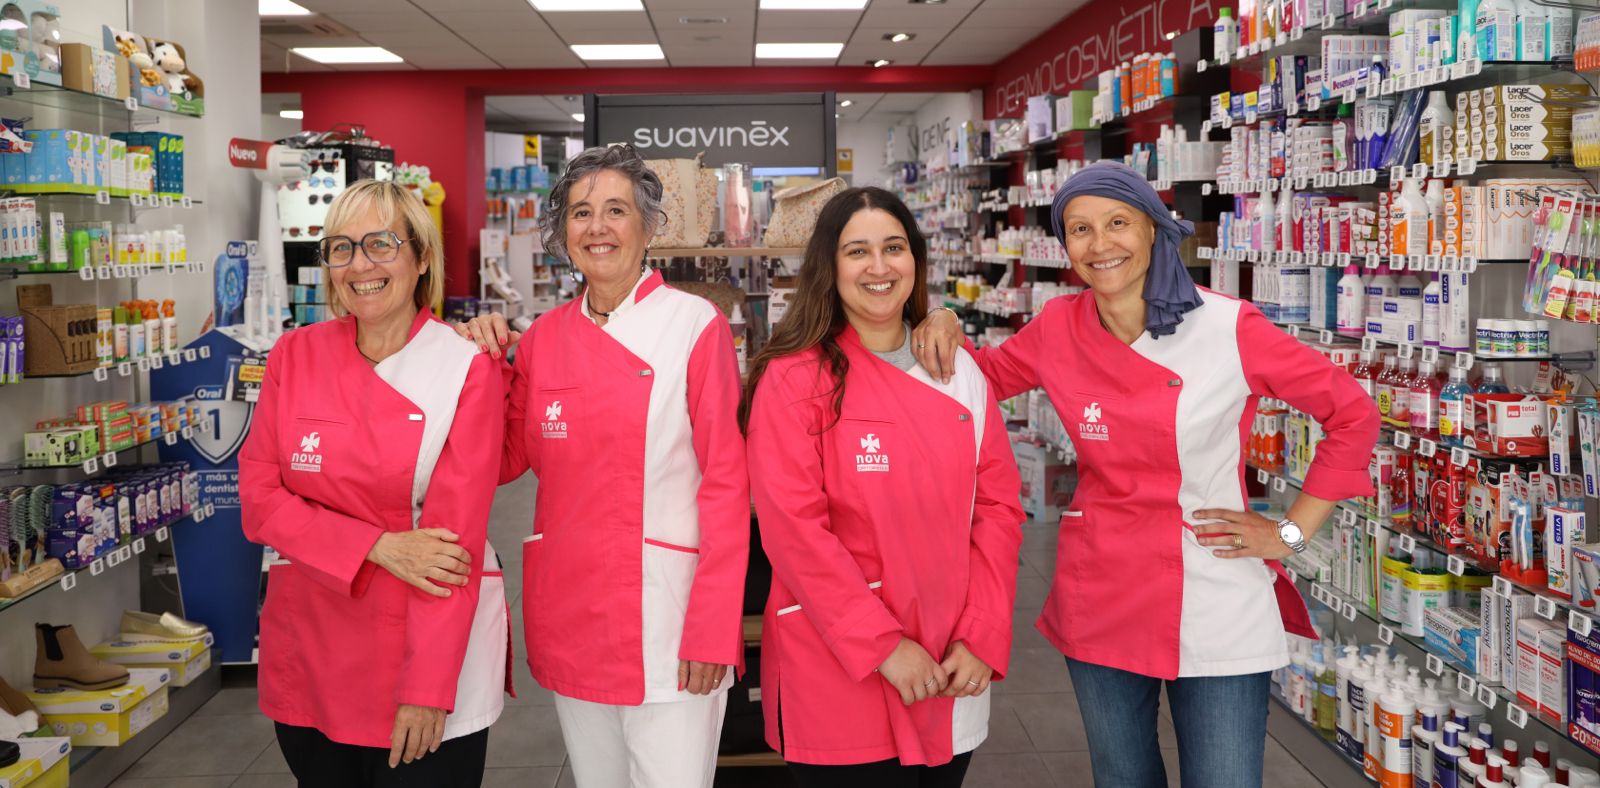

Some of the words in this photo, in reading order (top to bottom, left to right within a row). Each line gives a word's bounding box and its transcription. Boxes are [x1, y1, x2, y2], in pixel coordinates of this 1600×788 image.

[995, 0, 1213, 117] DERMOCOSMÈTICA
[1507, 86, 1531, 94] Lacer
[230, 145, 257, 161] Nuevo
[1425, 295, 1439, 303] VIT
[197, 388, 222, 399] Oral
[207, 408, 221, 440] 1
[541, 422, 567, 431] nova
[1079, 423, 1108, 434] nova
[291, 453, 322, 464] nova
[856, 455, 888, 464] nova
[206, 472, 227, 481] más
